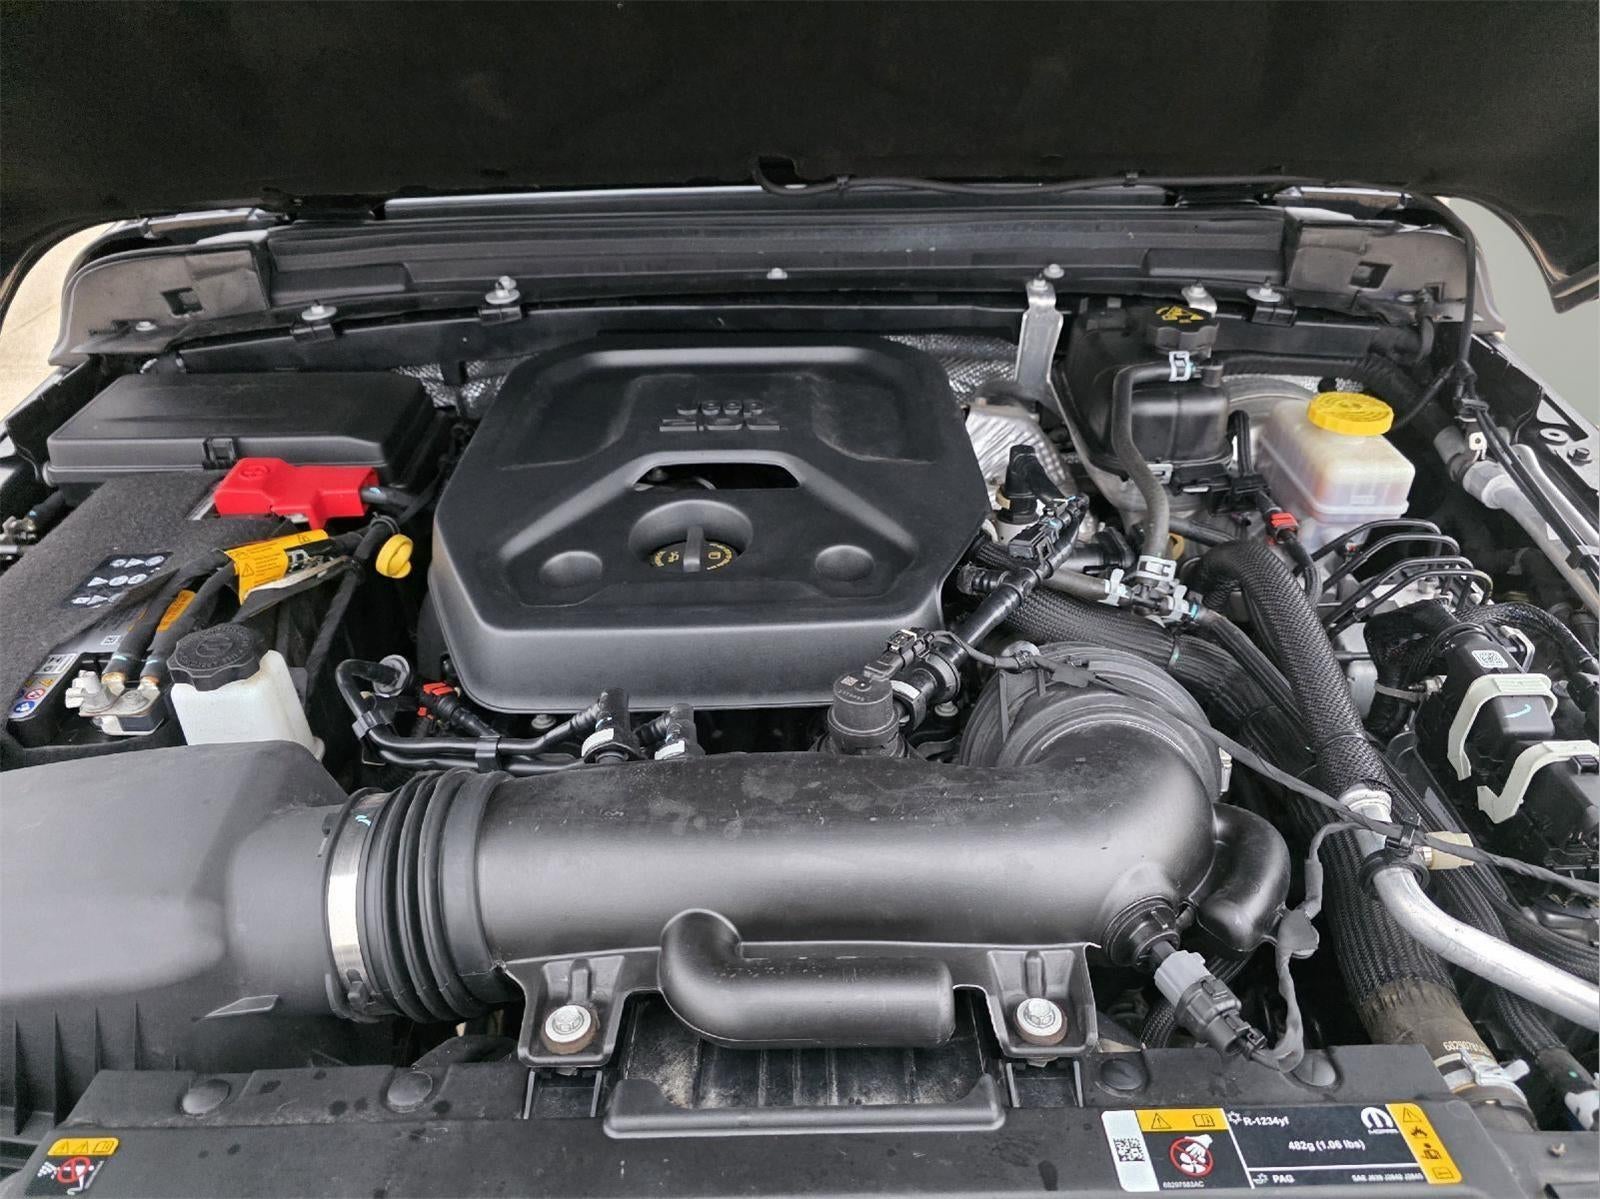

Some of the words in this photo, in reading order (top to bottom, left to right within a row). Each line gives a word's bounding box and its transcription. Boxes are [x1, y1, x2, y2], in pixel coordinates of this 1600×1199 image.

[1242, 1116, 1290, 1127] R-1234yf
[1288, 1140, 1315, 1151] 482g
[1316, 1140, 1342, 1151] (1.06
[1344, 1139, 1366, 1150] lbs)
[1272, 1174, 1295, 1184] PAG
